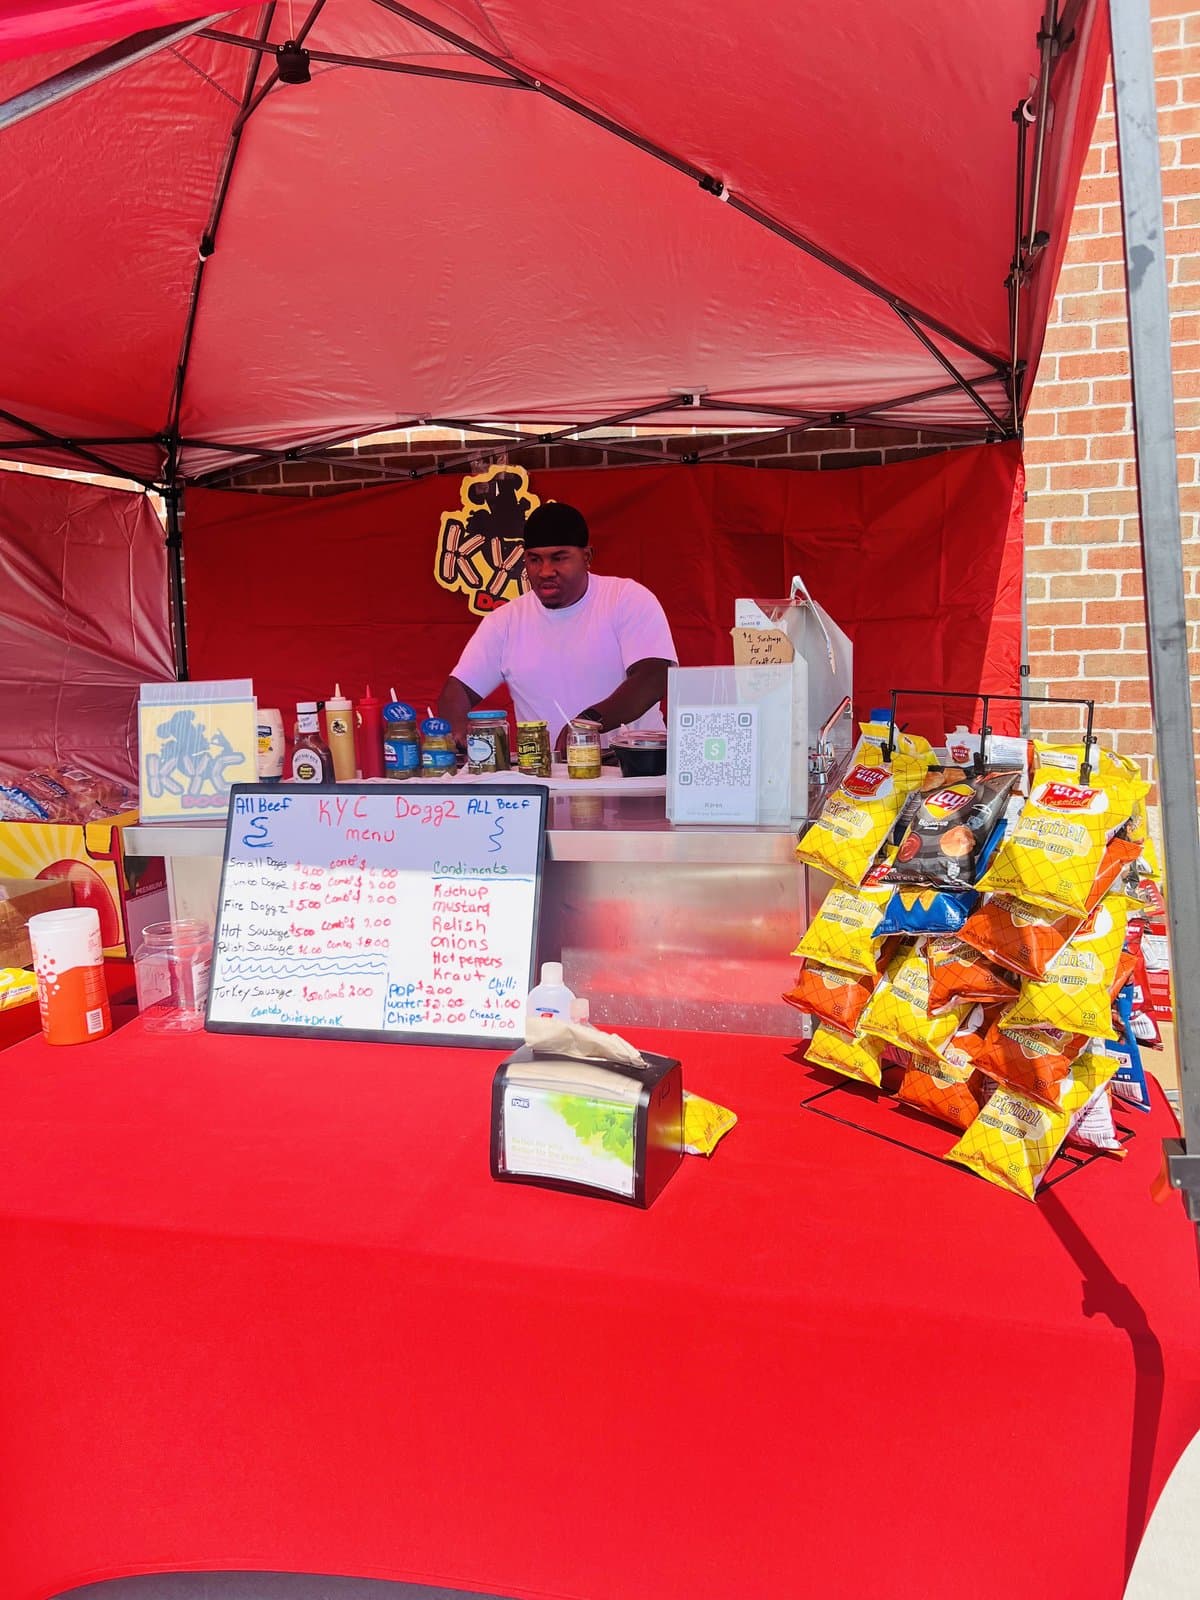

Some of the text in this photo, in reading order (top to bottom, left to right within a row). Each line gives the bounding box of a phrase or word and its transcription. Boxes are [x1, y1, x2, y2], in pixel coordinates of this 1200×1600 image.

[439, 518, 533, 596] KY
[145, 752, 246, 798] KYC
[235, 798, 254, 814] All
[259, 798, 292, 812] Beef
[319, 796, 368, 827] KYC
[467, 799, 530, 815] ALL Beef
[346, 829, 395, 842] menu
[229, 858, 262, 868] Small
[223, 899, 244, 912] Fire
[221, 923, 241, 938] Hot
[248, 924, 290, 942] Sausage
[432, 916, 486, 934] Relish
[248, 941, 295, 956] Sausage
[433, 951, 503, 968] Hot peppers
[433, 968, 485, 981] Kraut
[214, 984, 251, 1003] Turkey
[251, 986, 293, 1001] Sausage
[484, 998, 521, 1009] $1.00
[387, 1011, 466, 1025] Chips $2.00
[1083, 1012, 1096, 1020] 230
[481, 1020, 515, 1029] $1.00
[1024, 1039, 1049, 1056] CHIPS
